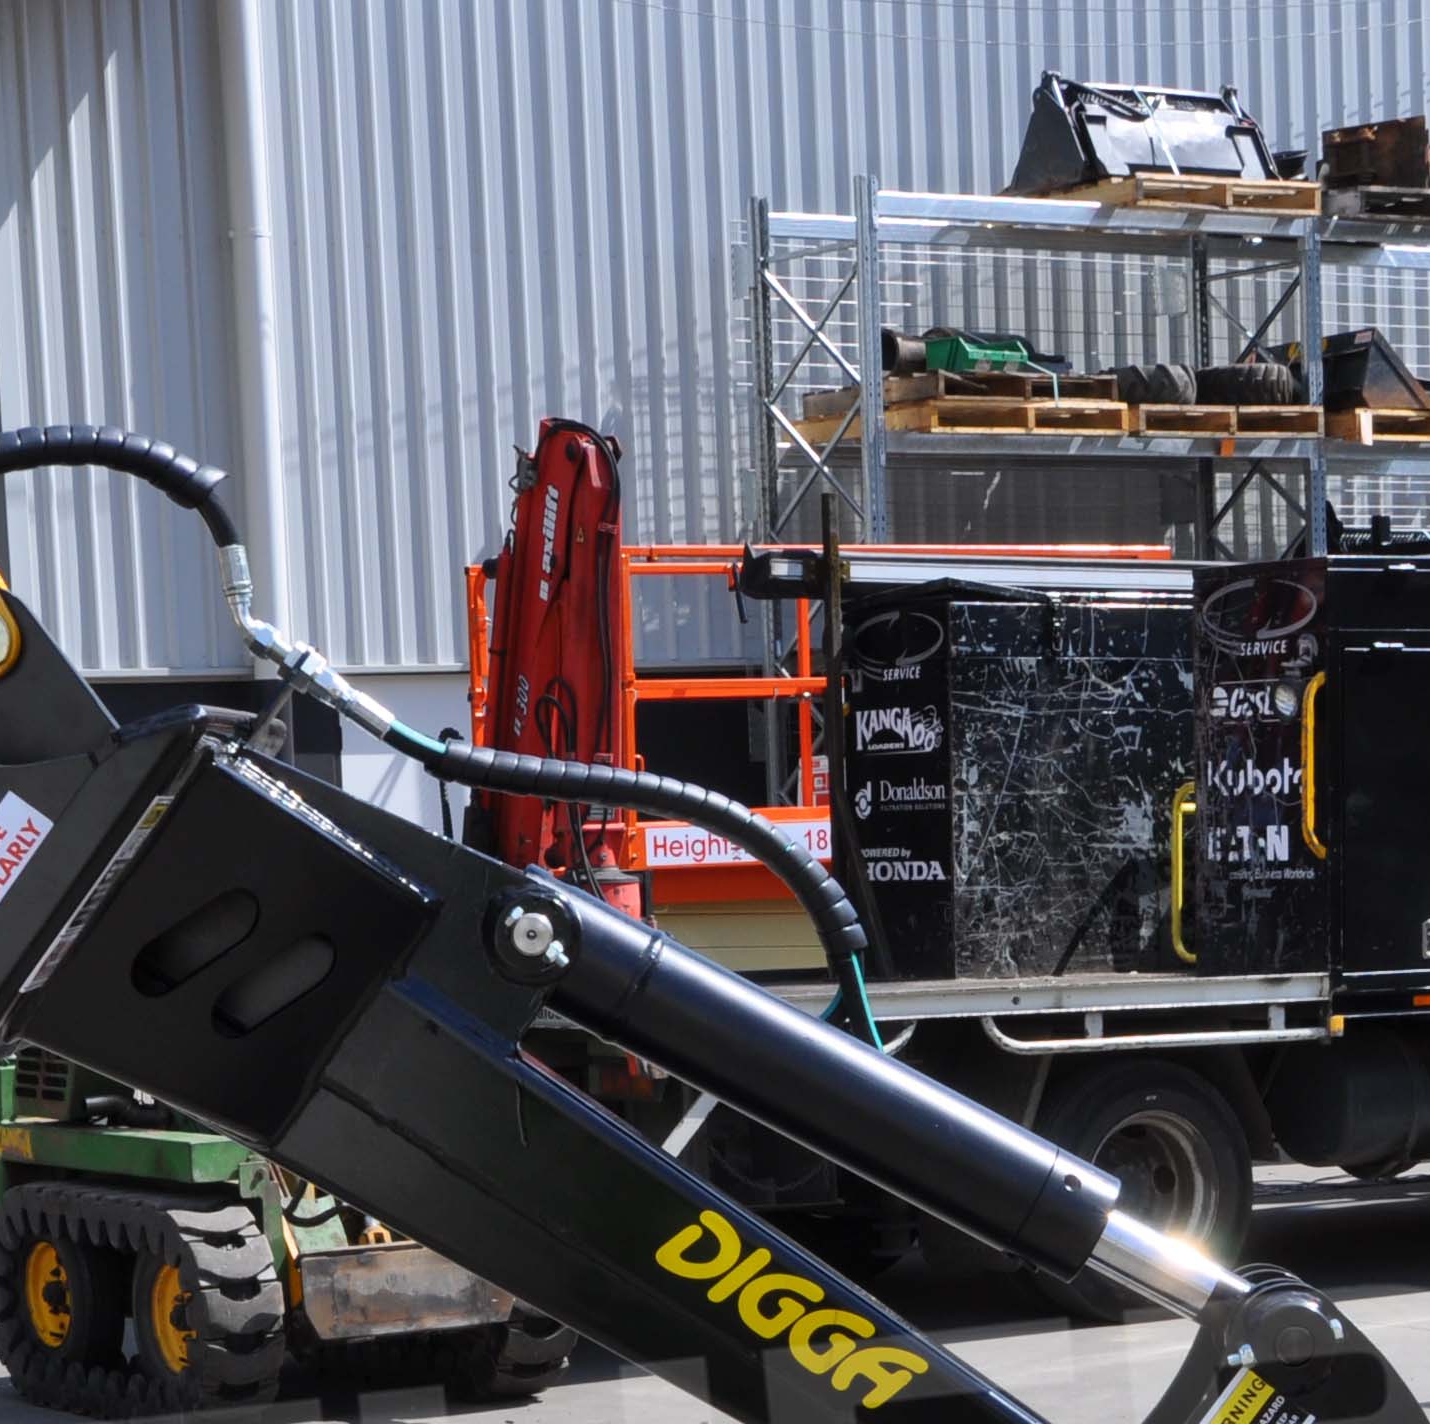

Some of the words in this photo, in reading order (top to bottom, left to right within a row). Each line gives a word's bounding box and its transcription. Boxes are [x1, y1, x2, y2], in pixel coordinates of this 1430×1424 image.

[1239, 639, 1288, 657] SERVICE
[882, 666, 922, 681] SERVICE
[880, 777, 946, 802] Donaldson
[655, 1209, 929, 1409] DIGGA
